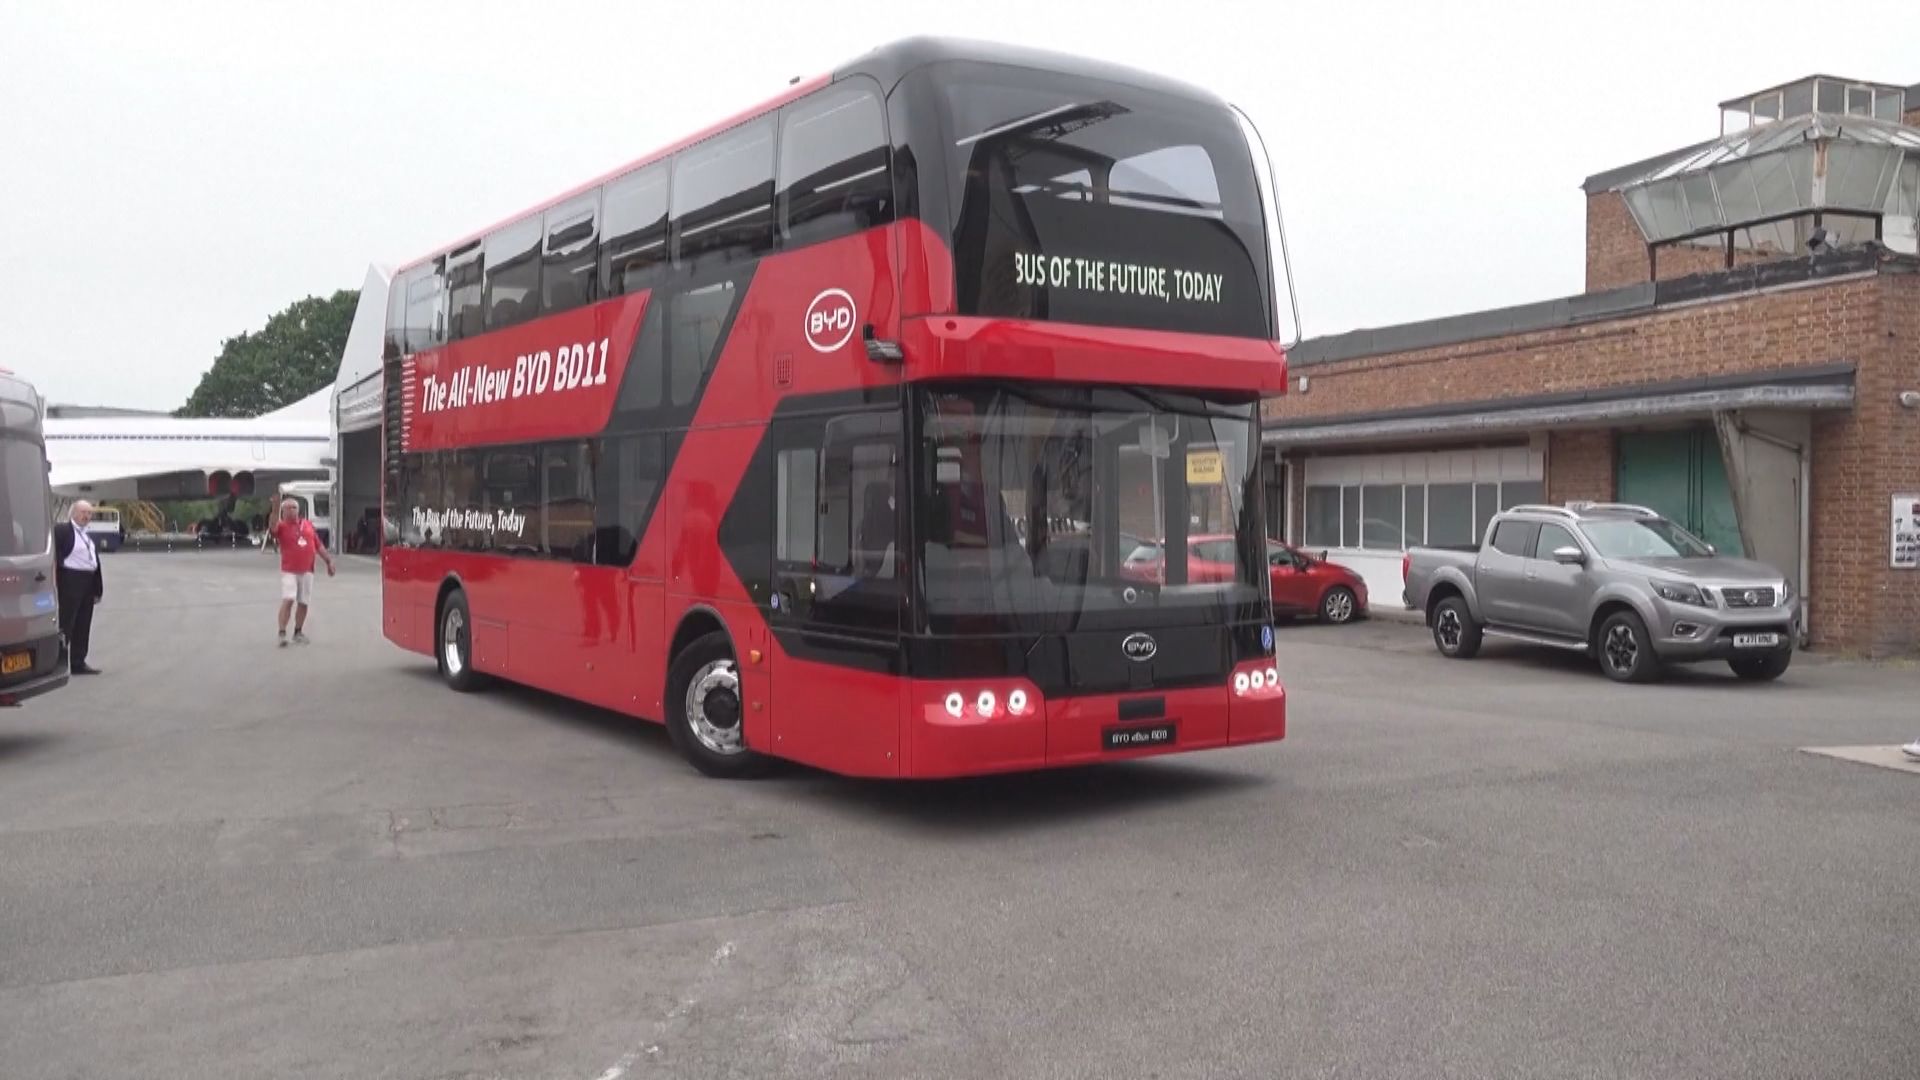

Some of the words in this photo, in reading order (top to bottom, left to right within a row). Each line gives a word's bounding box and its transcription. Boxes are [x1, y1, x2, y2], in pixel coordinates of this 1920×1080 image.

[1015, 252, 1046, 286] BUS
[1050, 256, 1072, 288] OF
[1075, 258, 1105, 292] THE
[1109, 262, 1170, 303] FUTURE,
[1174, 269, 1223, 303] TODAY
[811, 306, 850, 335] BYD
[422, 374, 447, 414] The
[447, 364, 511, 410] All-New
[512, 350, 551, 399] BYD
[553, 337, 609, 392] BD11
[412, 506, 426, 528] The
[426, 508, 440, 528] Bus
[441, 508, 450, 528] of
[450, 508, 463, 529] the
[464, 509, 495, 536] Future,
[497, 508, 526, 538] Today
[1127, 641, 1154, 652] BYD
[1112, 733, 1130, 744] BYD
